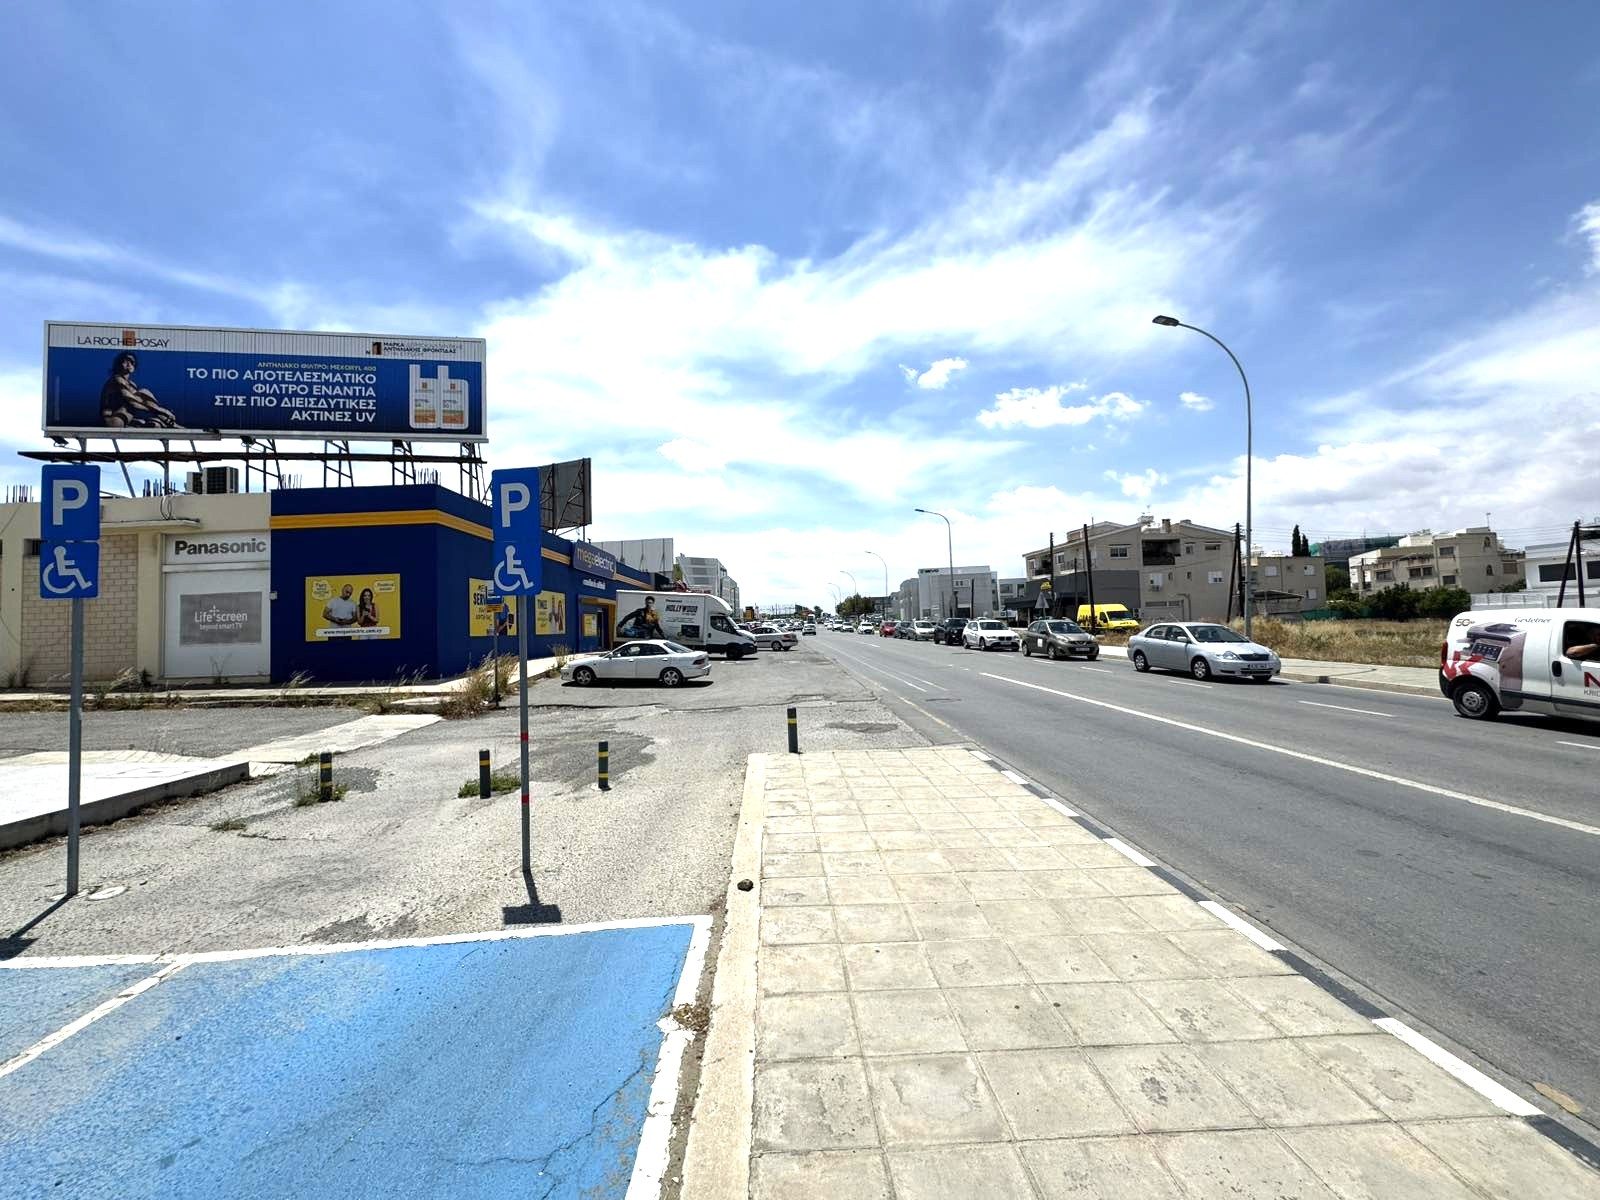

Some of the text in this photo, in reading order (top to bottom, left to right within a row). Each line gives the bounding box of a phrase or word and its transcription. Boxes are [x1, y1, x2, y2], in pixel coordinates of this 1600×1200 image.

[187, 368, 376, 384] ΤΟ ΠΙΟ ΑΠΟΤΕΛΕΣΜΑΤΙΚΟ
[253, 383, 376, 397] ΦΙΛΤΡΟ ΕΝΑΝΤΙΑ
[214, 395, 376, 410] ΣΤΙΣ ΠΙΟ ΔΙΕΙΣΔΥΤΙΚΕΣ
[291, 410, 376, 423] ΑΚΤΙΝΕΣ UV
[52, 479, 89, 526] P
[500, 482, 531, 528] P
[174, 537, 267, 555] Panasonic
